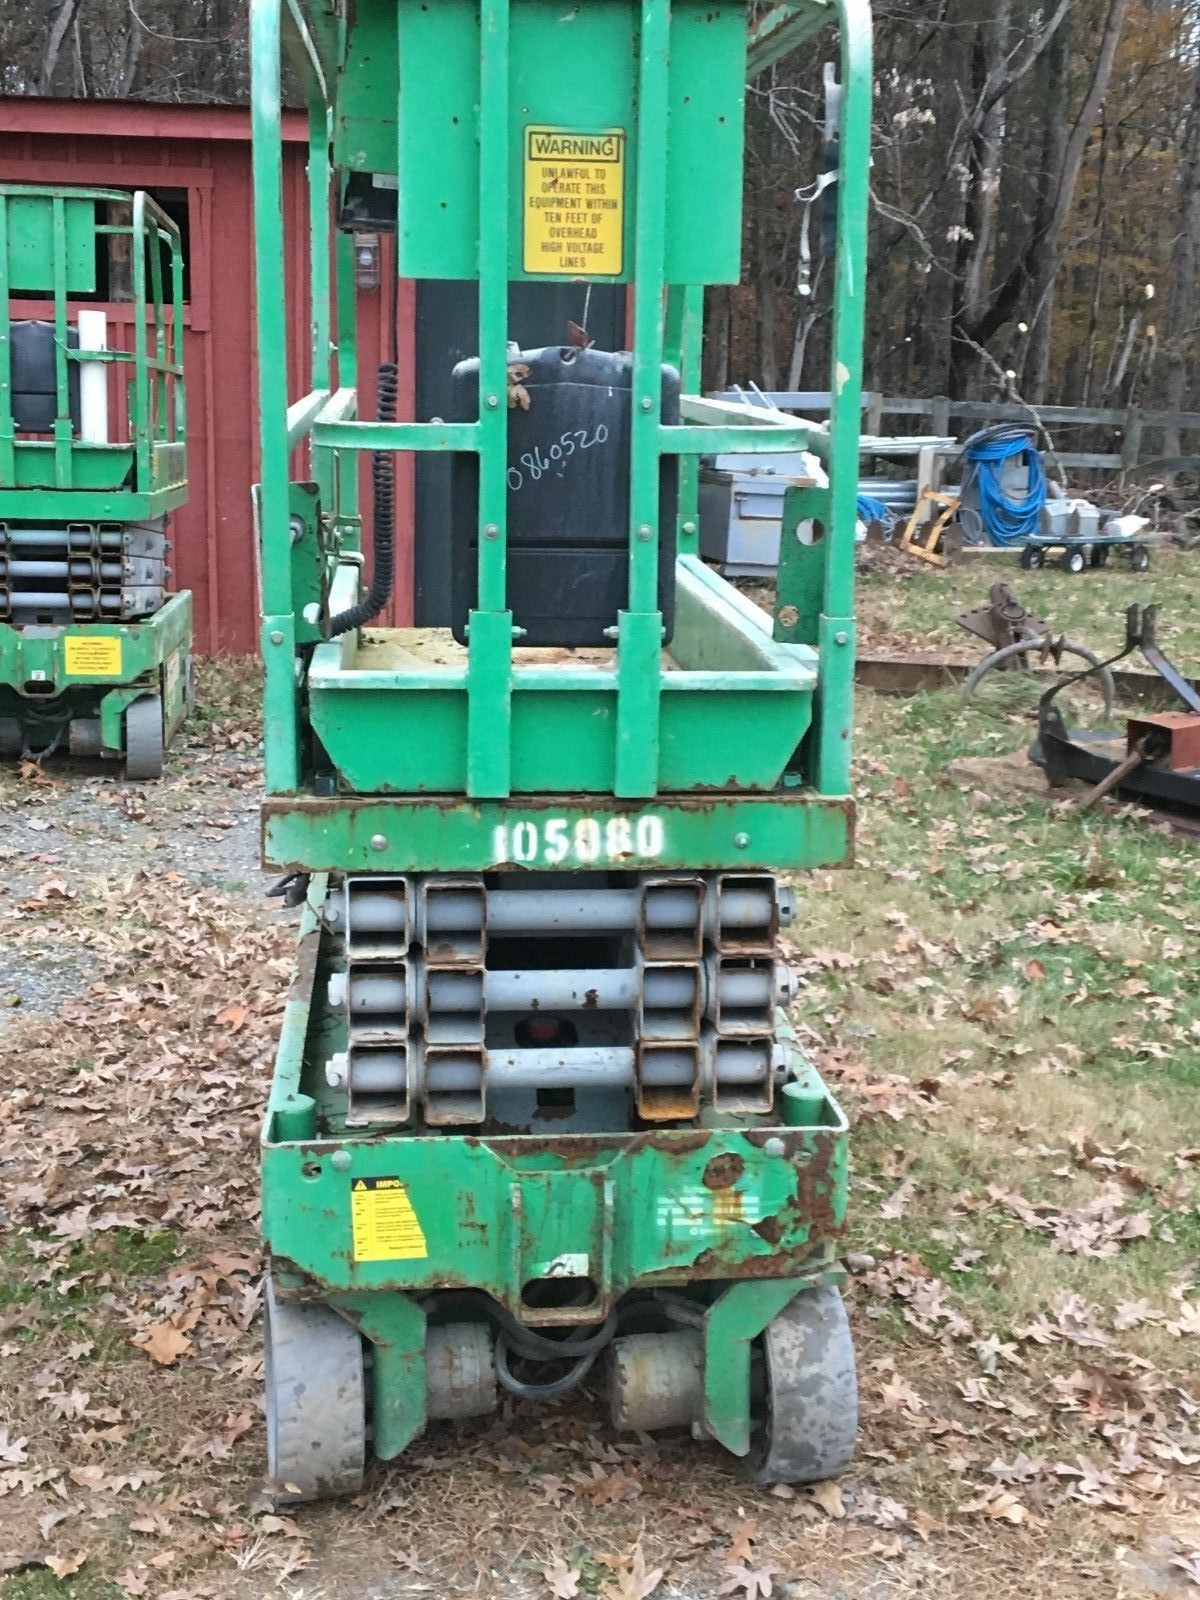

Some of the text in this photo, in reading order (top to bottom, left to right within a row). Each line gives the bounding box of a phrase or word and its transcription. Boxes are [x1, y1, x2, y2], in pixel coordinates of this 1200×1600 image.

[535, 138, 614, 156] WARNING
[541, 167, 607, 180] UNLAWFUL TO
[541, 182, 606, 195] OPERATE THIS
[529, 197, 618, 210] EQUIPMENT WITHIN
[544, 211, 604, 224] TEN FEET OF
[549, 227, 598, 239] OVERHEAD
[541, 241, 604, 254] HIGH VOLTAGE
[560, 256, 587, 268] LINES
